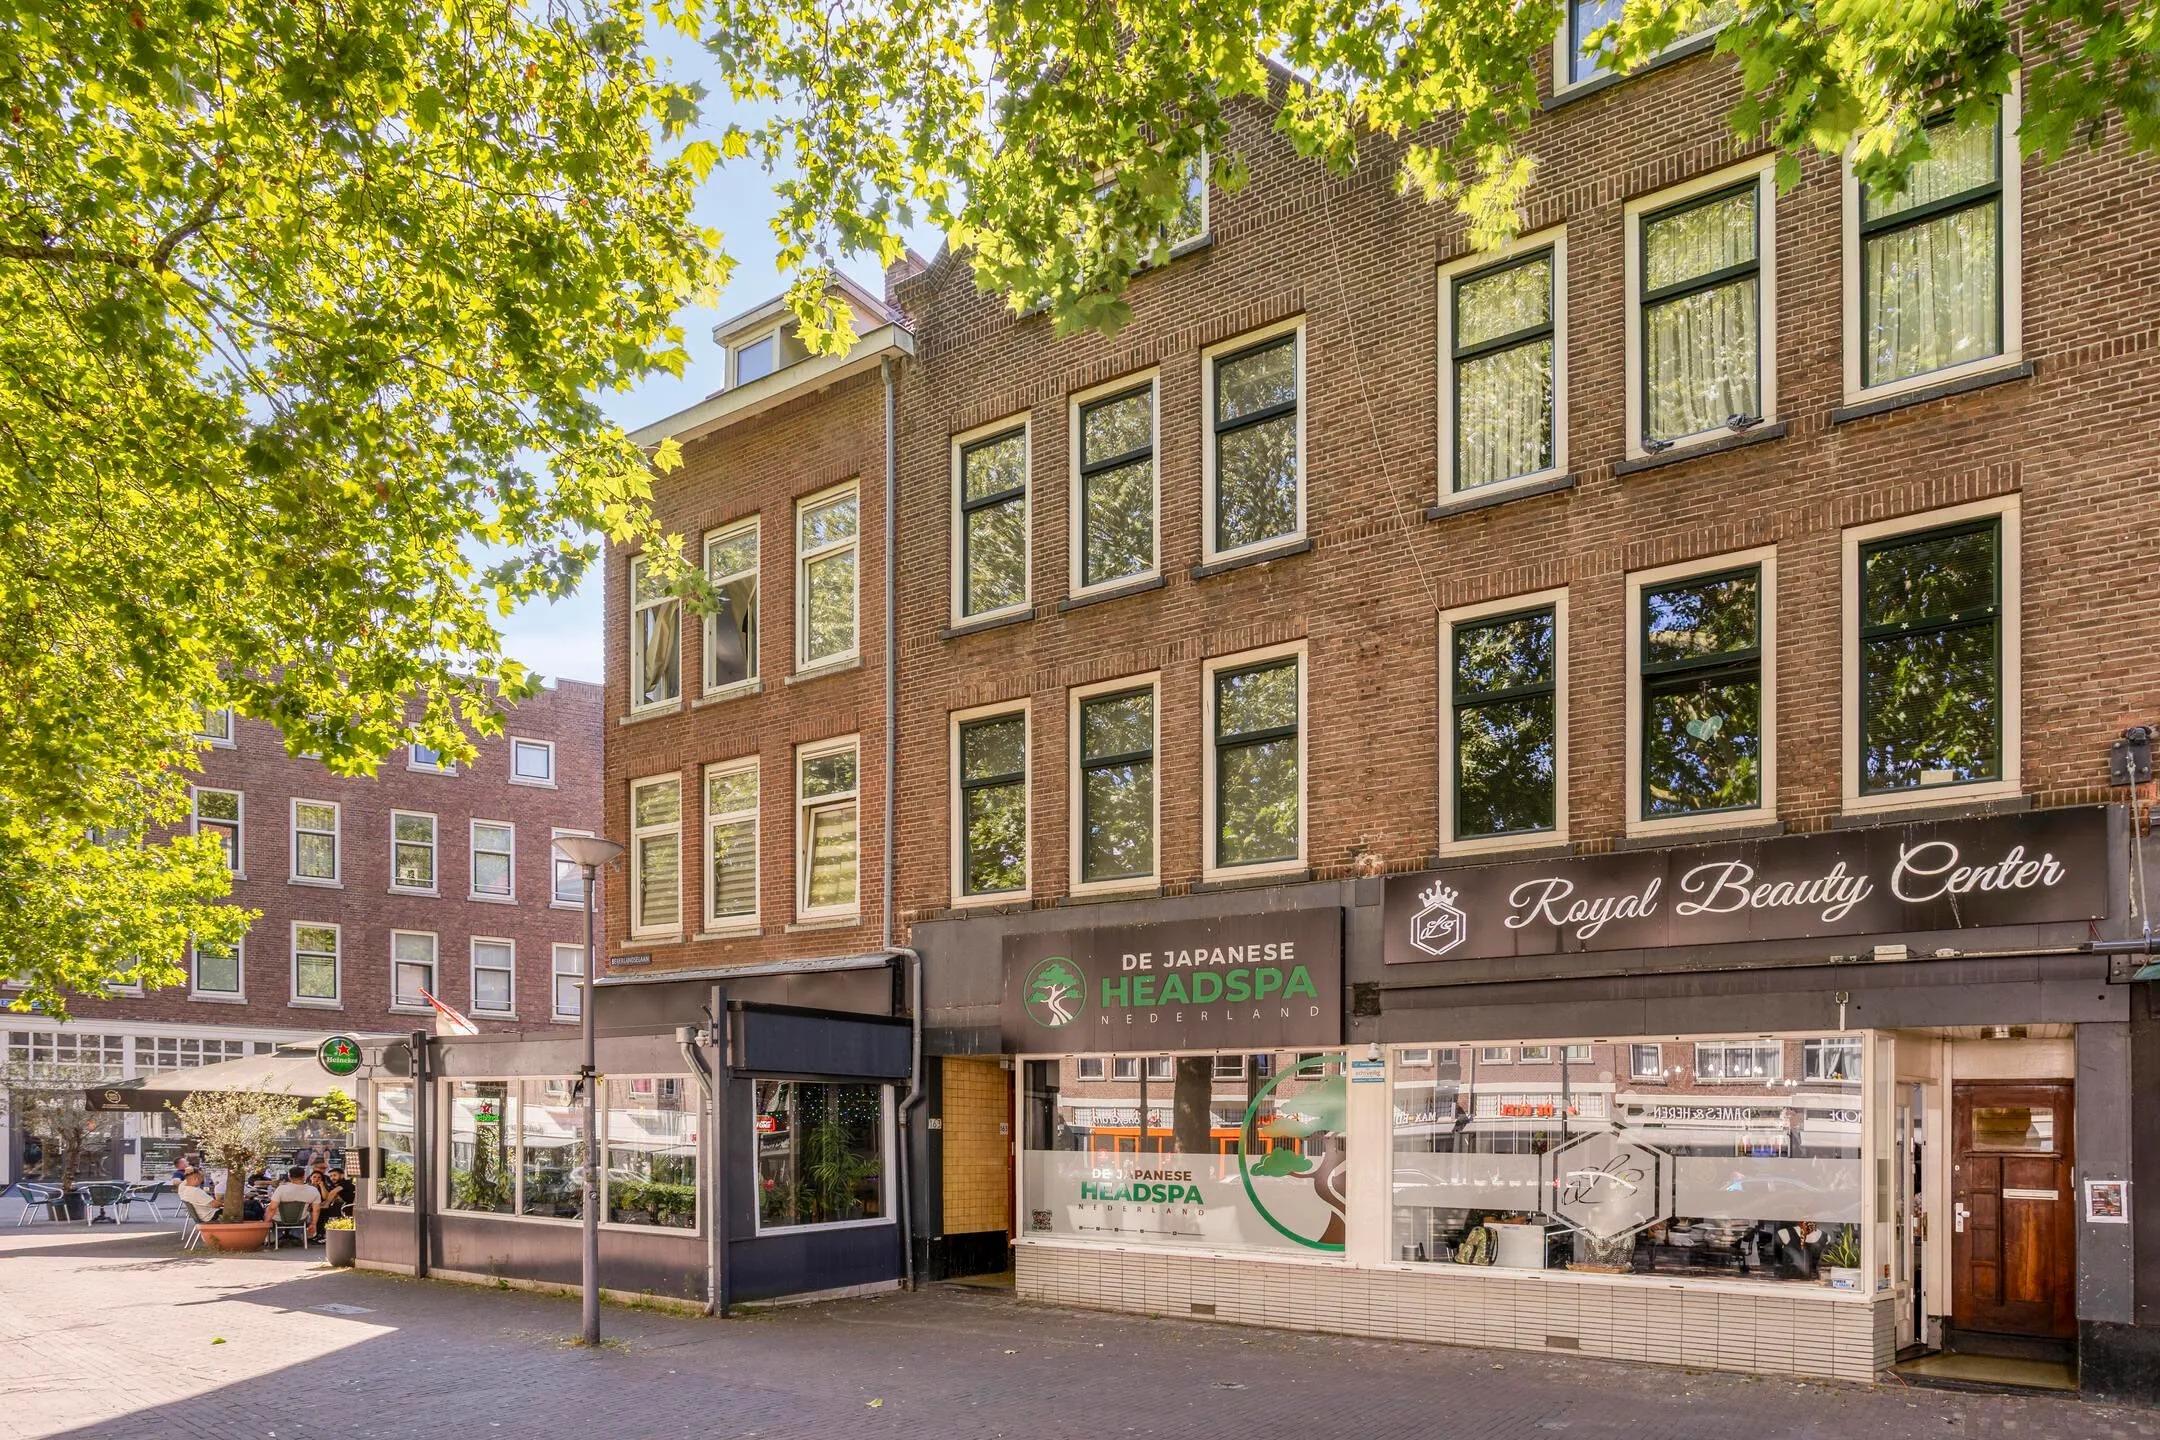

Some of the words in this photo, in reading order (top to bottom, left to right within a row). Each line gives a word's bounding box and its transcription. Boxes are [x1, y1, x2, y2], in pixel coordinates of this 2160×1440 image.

[1503, 876, 1662, 940] Royal
[1676, 859, 1874, 922] Beauty
[1891, 841, 2066, 903] Center
[1122, 952, 1153, 971] DE
[1163, 942, 1295, 968] JAPANESE
[1101, 965, 1318, 1008] HEADSPA
[1101, 1006, 1319, 1025] NEDERLAND
[1092, 1168, 1112, 1179] DE
[1116, 1169, 1192, 1181] JAPANESE
[1081, 1181, 1204, 1205] HEADSPA
[1078, 1203, 1204, 1216] NEDERLAND
